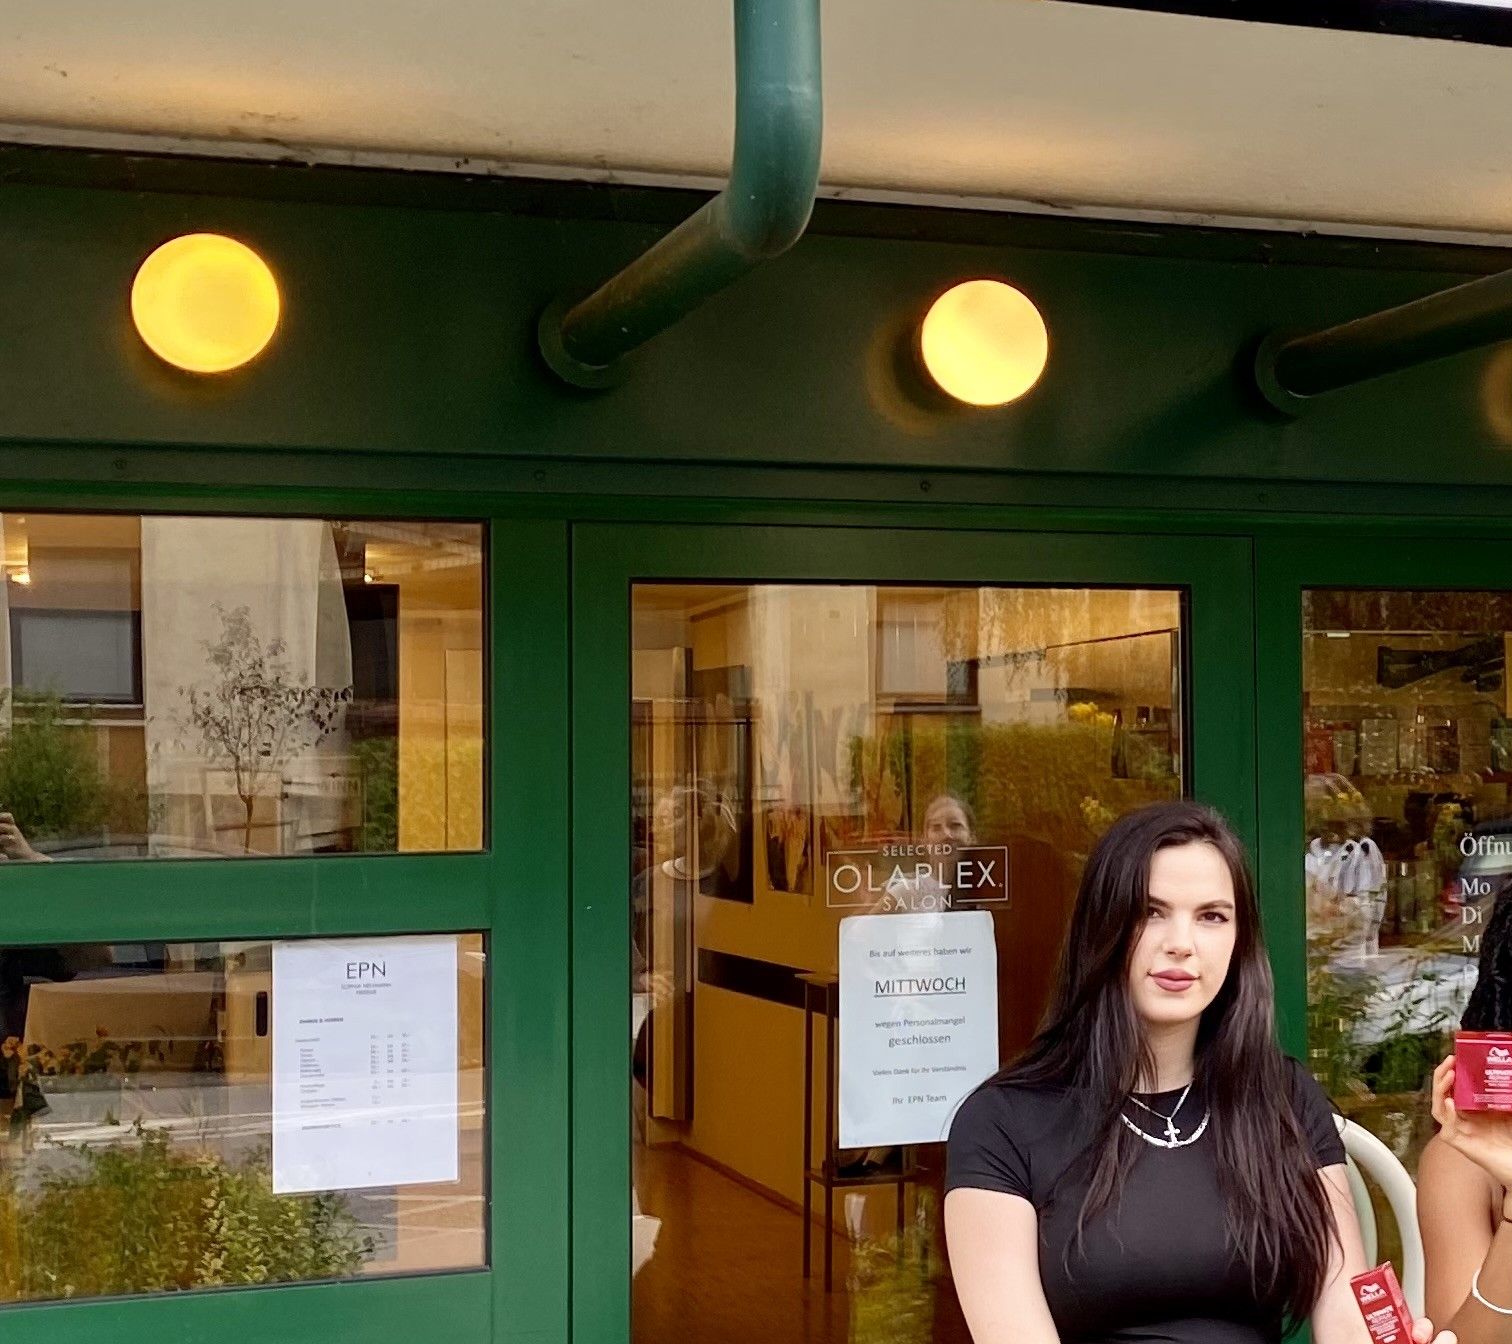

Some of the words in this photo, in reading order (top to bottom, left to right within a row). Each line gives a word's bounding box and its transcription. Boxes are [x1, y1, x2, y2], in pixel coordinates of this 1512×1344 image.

[882, 844, 953, 857] SELECTED
[1460, 877, 1491, 896] Mo
[881, 894, 953, 912] SALON
[1461, 905, 1482, 925] Di
[1462, 935, 1480, 953] M
[346, 961, 386, 981] EPN
[874, 976, 966, 994] MITTWOCH
[888, 1034, 951, 1049] geschlossen
[926, 1094, 947, 1103] Team
